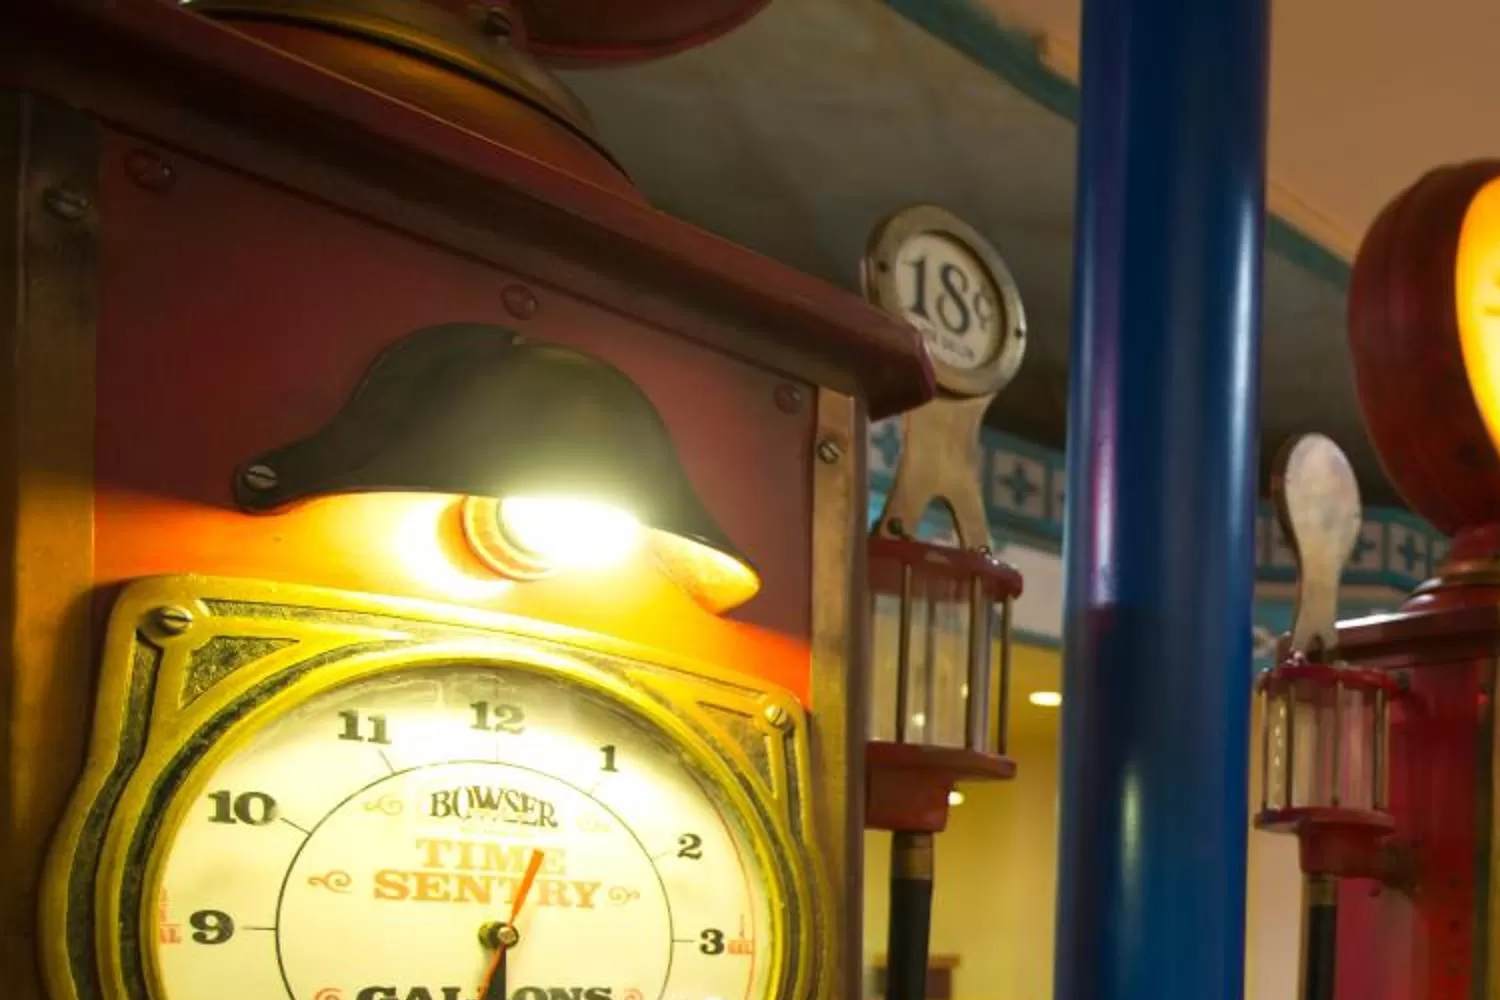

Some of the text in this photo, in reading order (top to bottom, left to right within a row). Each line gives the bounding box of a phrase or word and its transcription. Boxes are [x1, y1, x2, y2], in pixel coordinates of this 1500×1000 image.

[338, 709, 392, 745] 11
[469, 700, 525, 735] 12
[599, 744, 619, 773] 1
[207, 789, 277, 826] 10
[429, 784, 559, 828] BOWSER
[415, 837, 567, 876] TIME
[677, 832, 703, 859] 2
[373, 870, 602, 909] SENTRY
[189, 909, 235, 945] 9
[699, 928, 725, 955] 3
